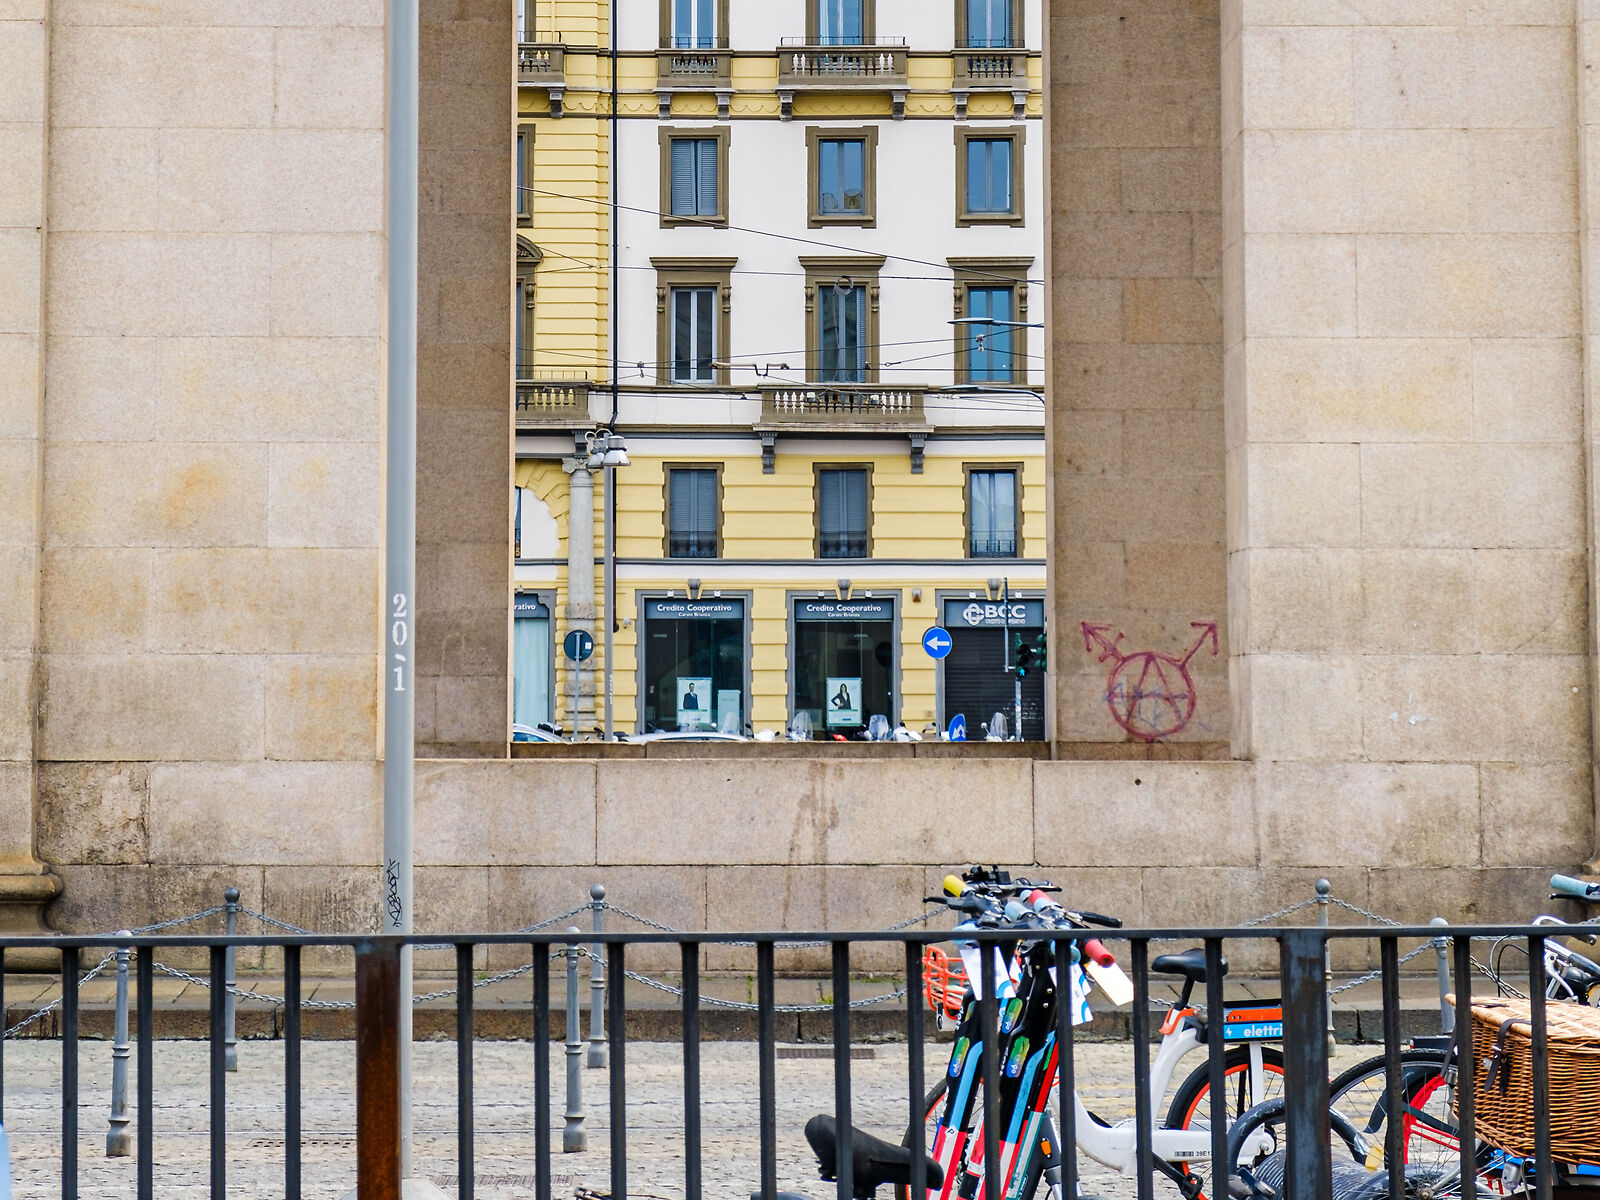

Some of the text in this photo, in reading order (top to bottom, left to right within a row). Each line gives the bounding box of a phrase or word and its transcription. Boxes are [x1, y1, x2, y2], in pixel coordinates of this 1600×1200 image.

[657, 604, 732, 613] Credito Cooperativo
[806, 604, 882, 613] Credito Cooperativo
[985, 605, 1026, 618] BCC
[1243, 1023, 1283, 1037] elettri
